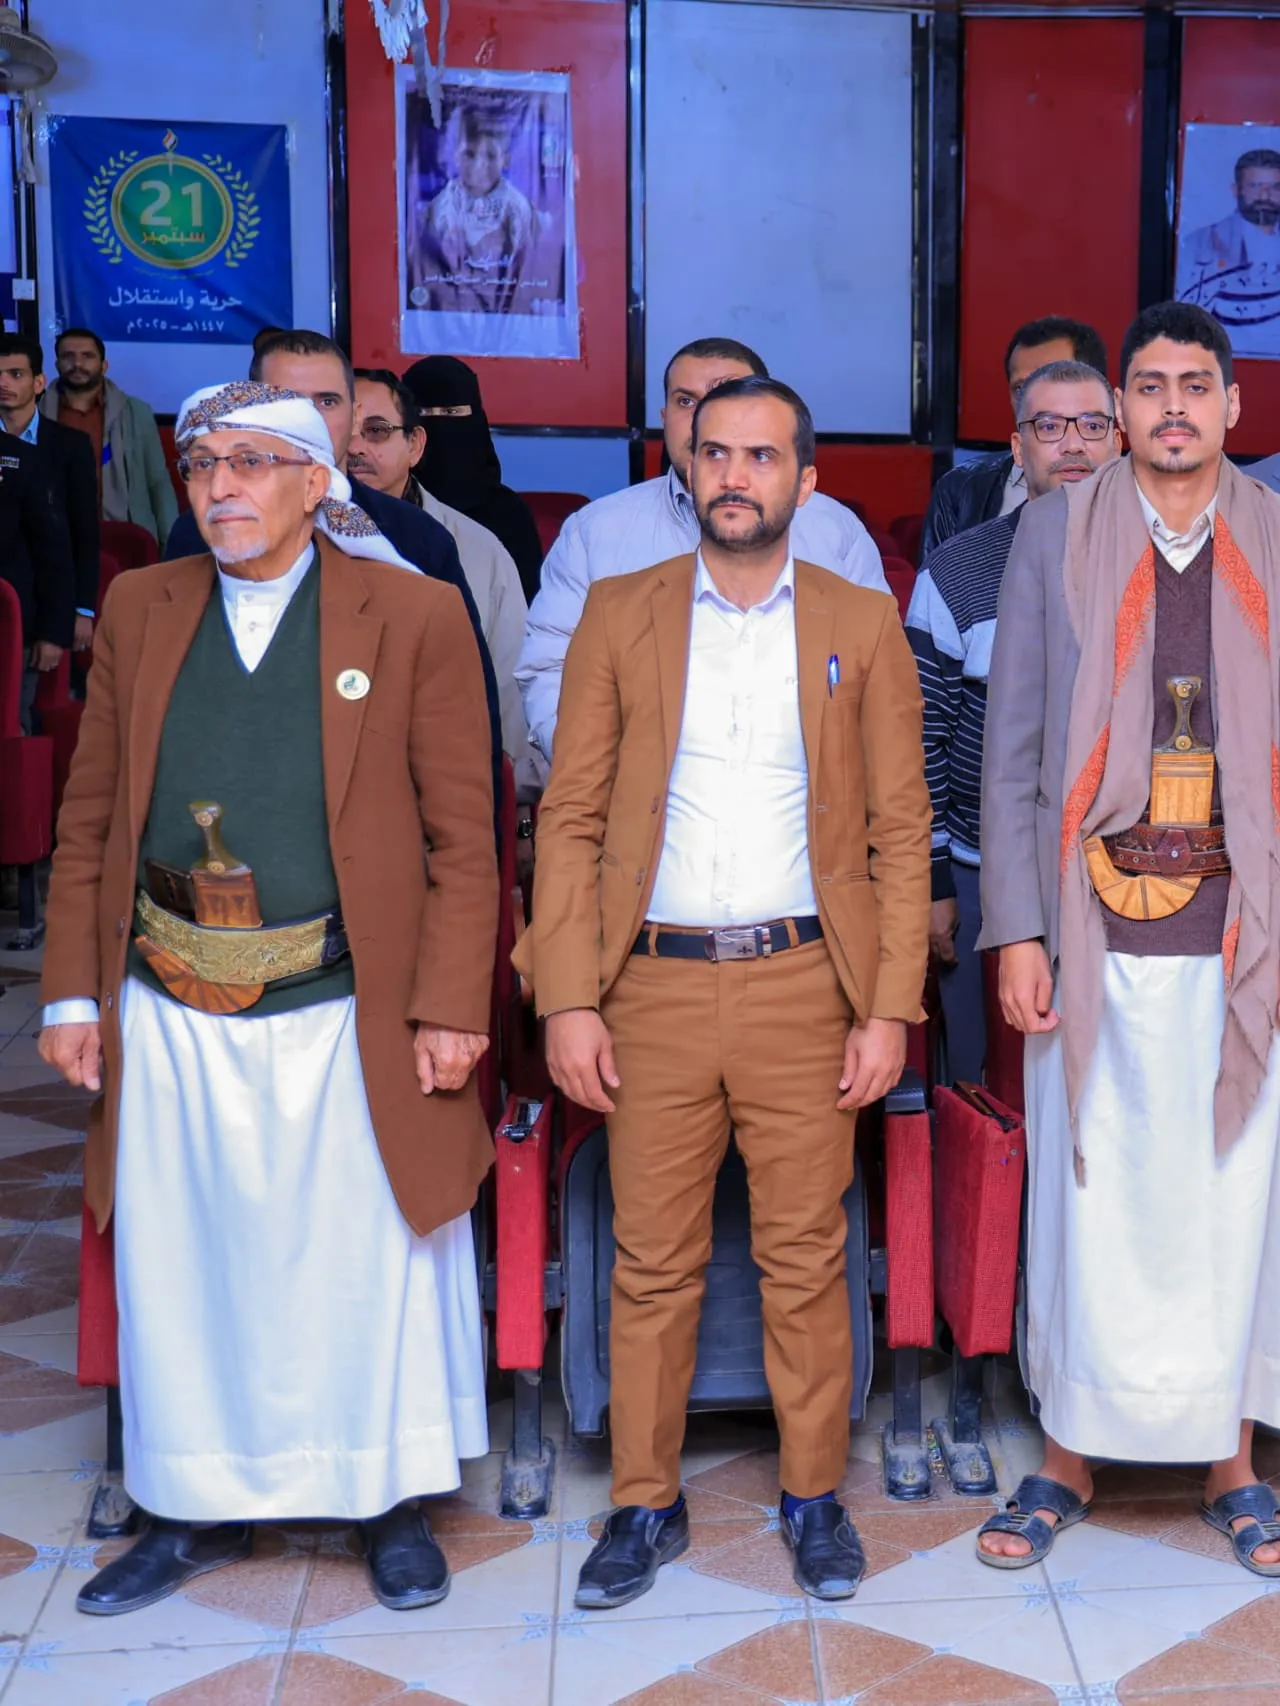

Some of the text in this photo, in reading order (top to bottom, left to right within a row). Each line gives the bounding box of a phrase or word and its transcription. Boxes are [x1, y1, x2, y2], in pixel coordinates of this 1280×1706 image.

[140, 180, 204, 227] 21
[142, 227, 206, 246] سبتمبر
[109, 286, 243, 311] حرية واستقلال
